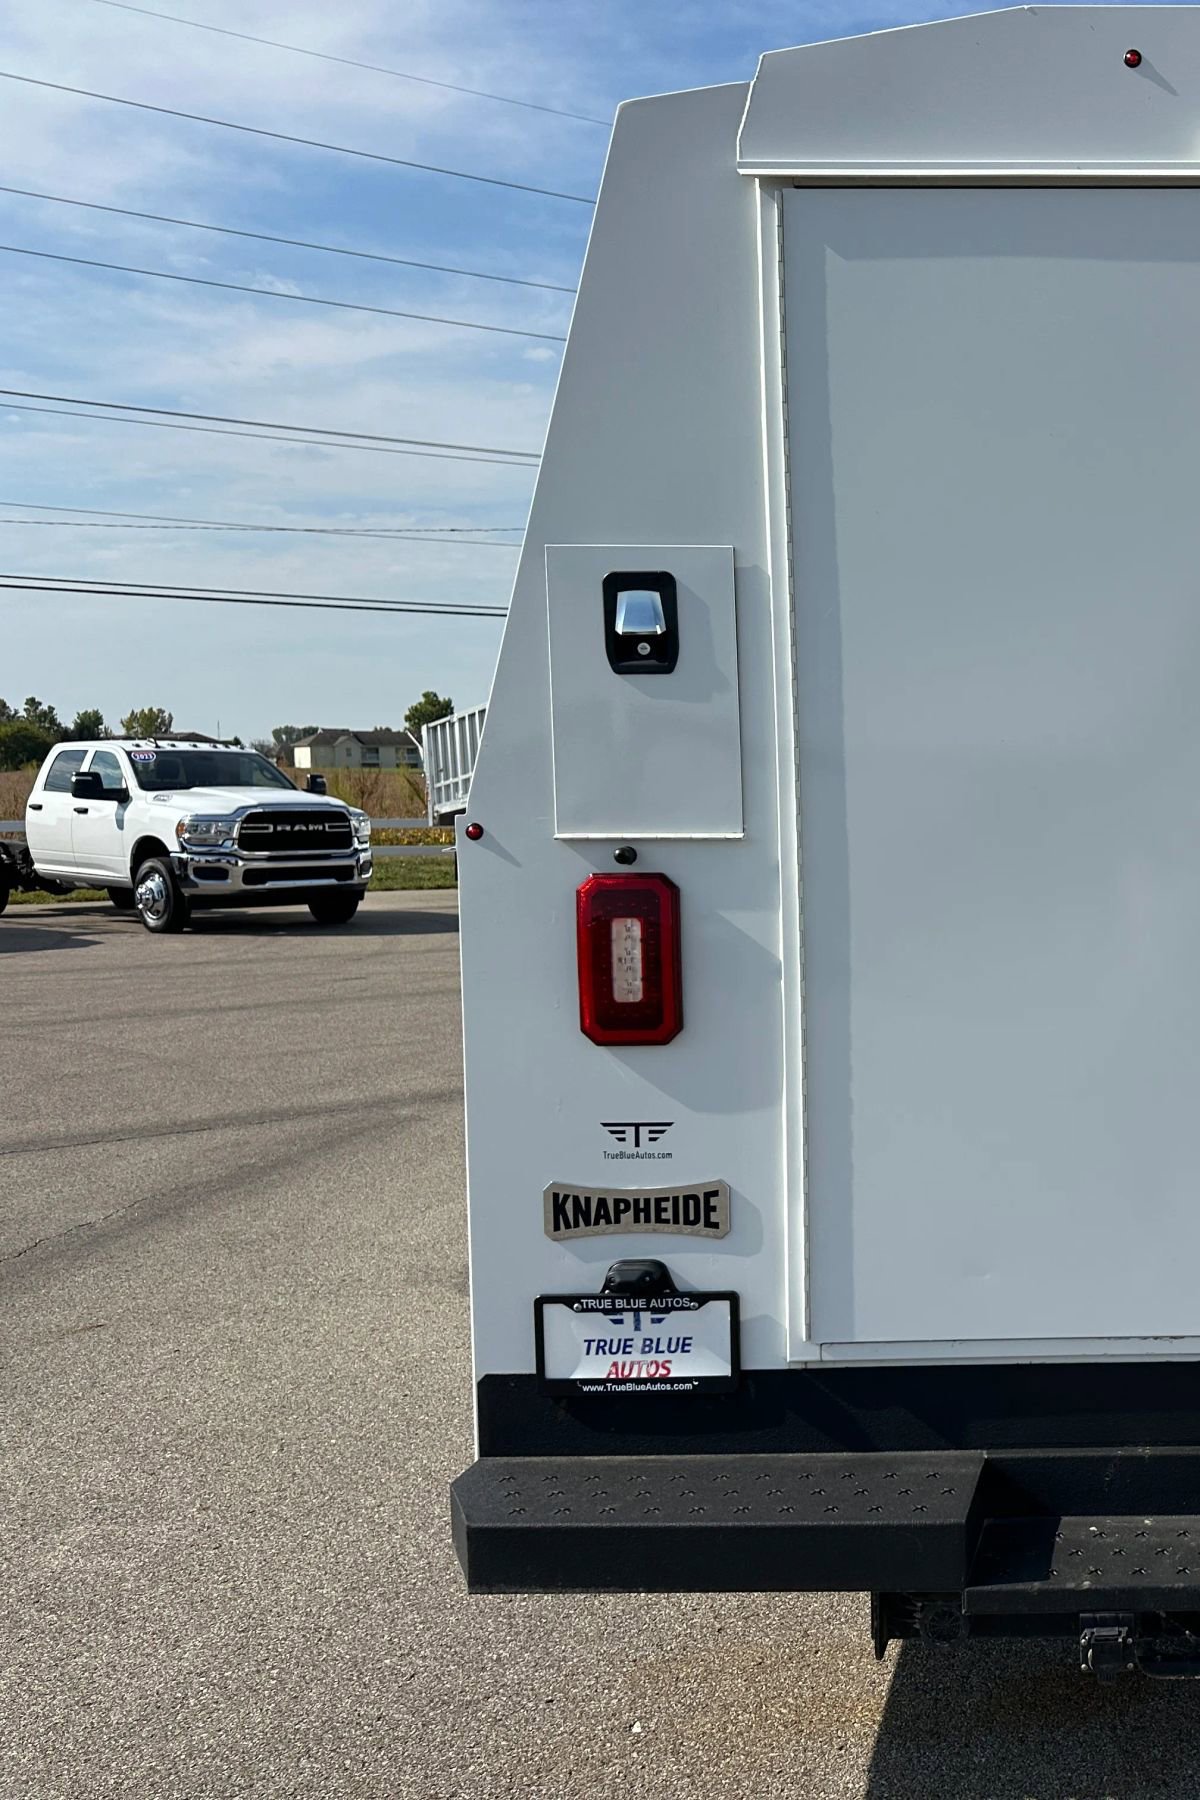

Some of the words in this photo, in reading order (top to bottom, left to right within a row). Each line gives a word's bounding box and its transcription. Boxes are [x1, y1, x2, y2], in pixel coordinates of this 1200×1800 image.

[276, 823, 323, 832] RAM
[603, 1150, 673, 1160] TrueBlueAutos.com
[552, 1189, 720, 1232] KNAPHEIDE
[581, 1299, 613, 1309] TRUE
[615, 1298, 647, 1309] BLUE
[650, 1297, 691, 1308] AUTOS
[583, 1338, 634, 1356] TRUE
[640, 1336, 693, 1354] BLUE
[606, 1360, 673, 1379] AUTOS
[582, 1382, 693, 1392] www.TrueBlueAutos.com
